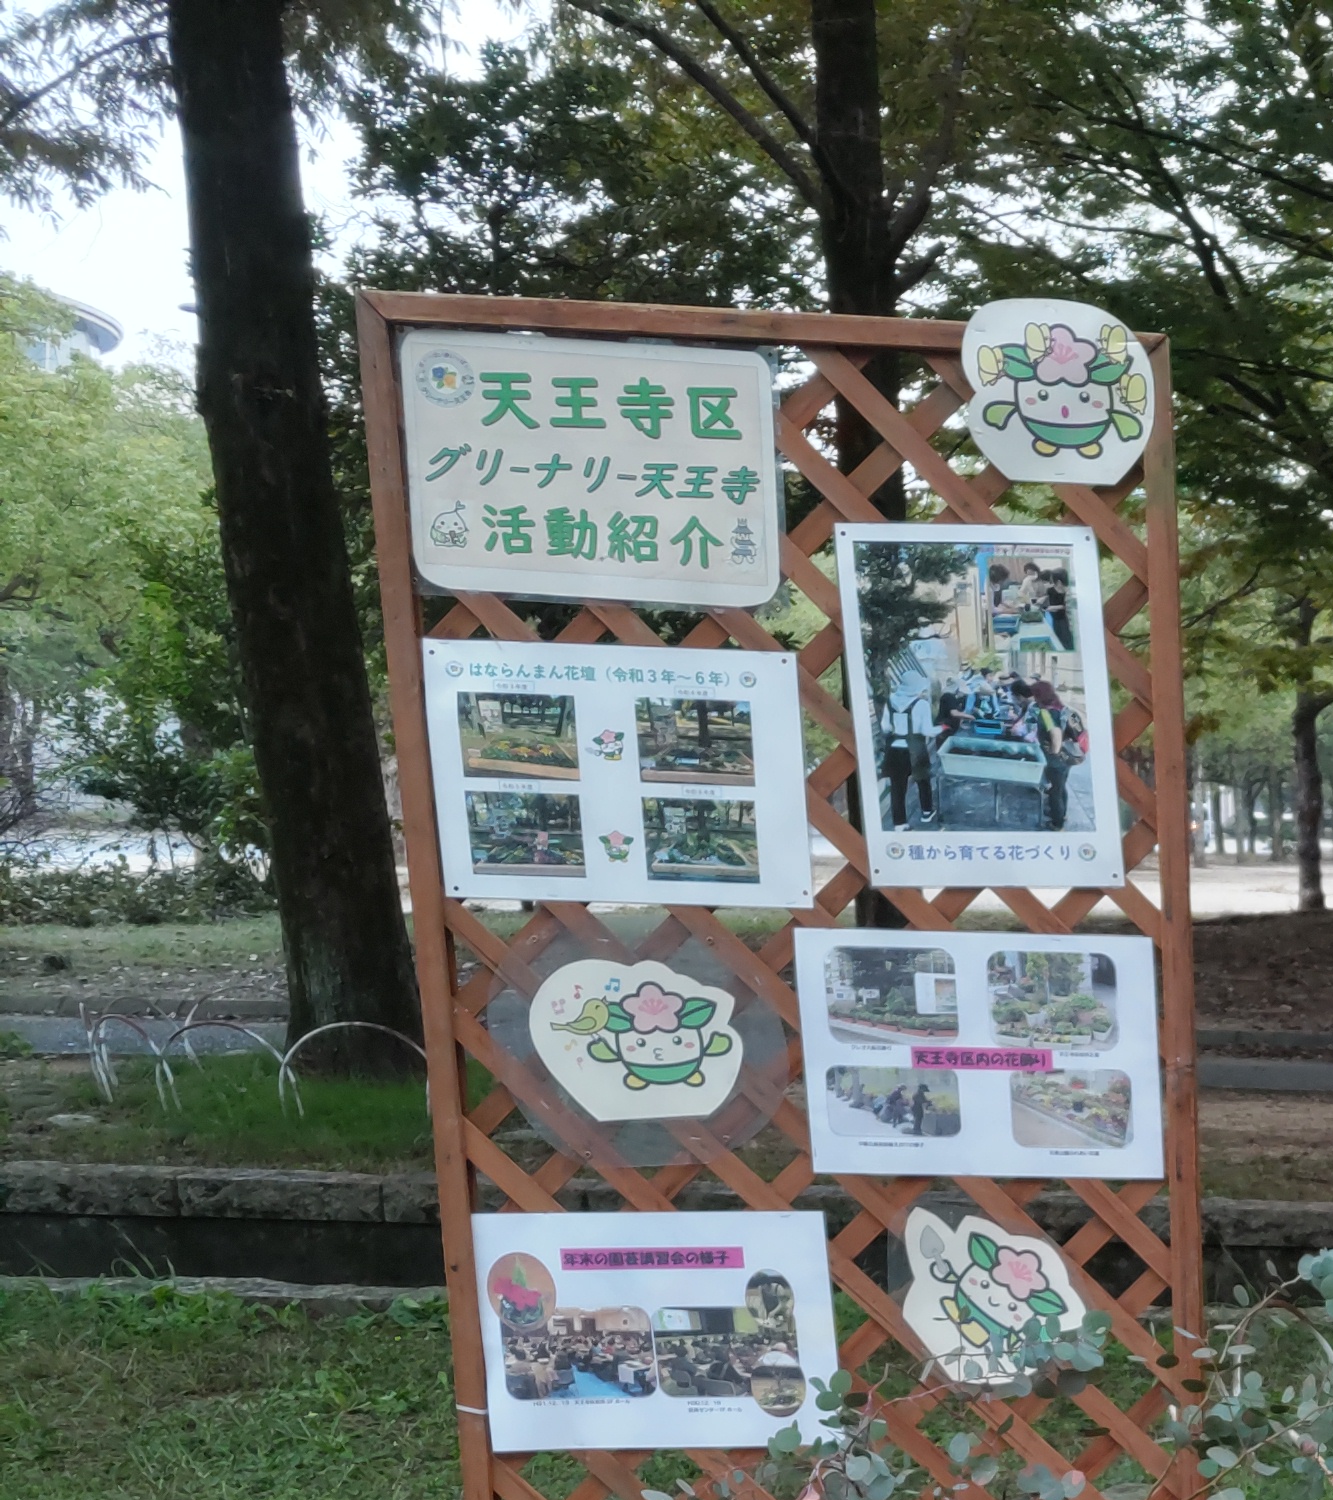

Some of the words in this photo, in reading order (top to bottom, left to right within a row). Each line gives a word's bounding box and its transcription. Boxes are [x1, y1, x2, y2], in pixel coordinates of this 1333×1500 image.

[479, 372, 743, 440] 天王寺区
[425, 443, 761, 505] グリーナリー天王寺
[482, 503, 724, 569] 活動紹介
[908, 844, 1071, 861] 種から育てる花づくり
